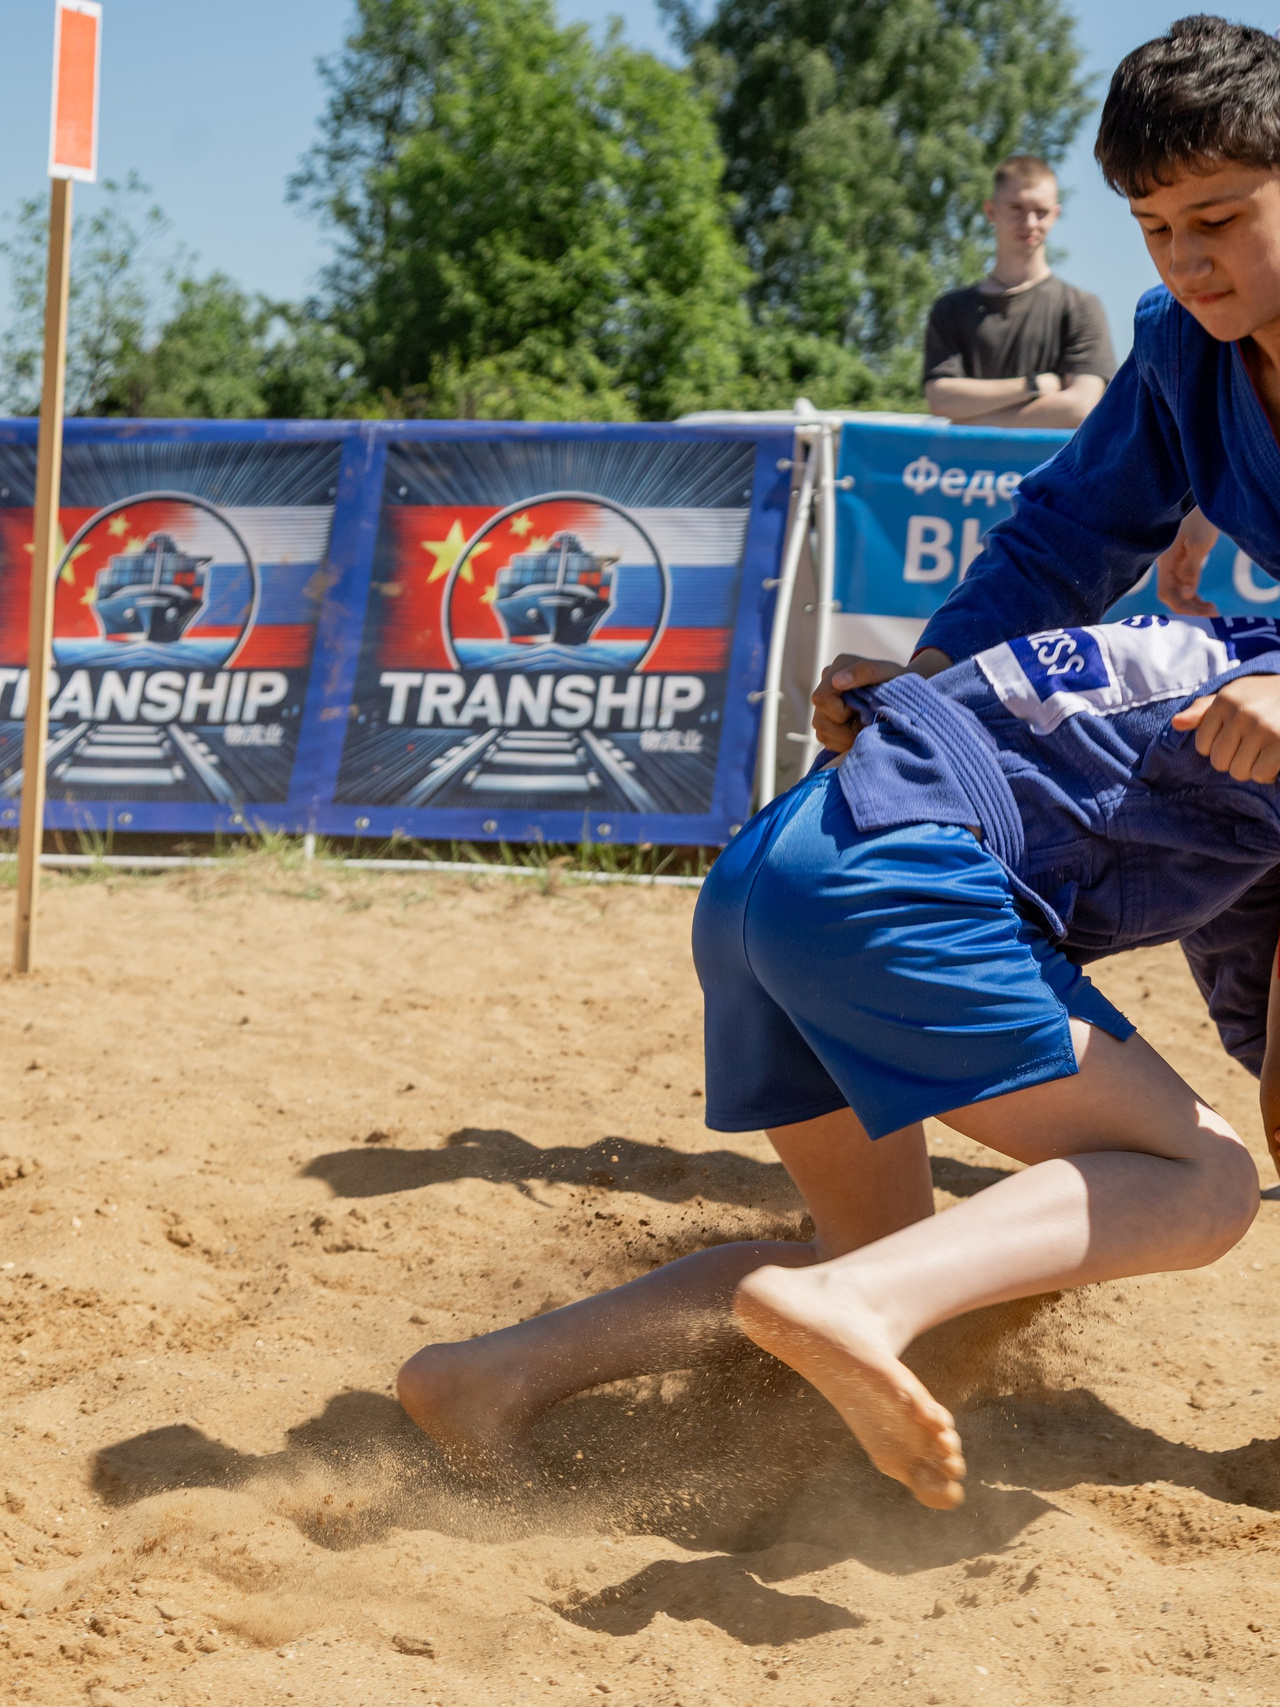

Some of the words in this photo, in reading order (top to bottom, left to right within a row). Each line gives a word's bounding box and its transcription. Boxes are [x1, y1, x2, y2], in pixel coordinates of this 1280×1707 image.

[902, 455, 1023, 507] Феде
[1027, 628, 1085, 676] ESS
[379, 671, 706, 729] TRANSHIP
